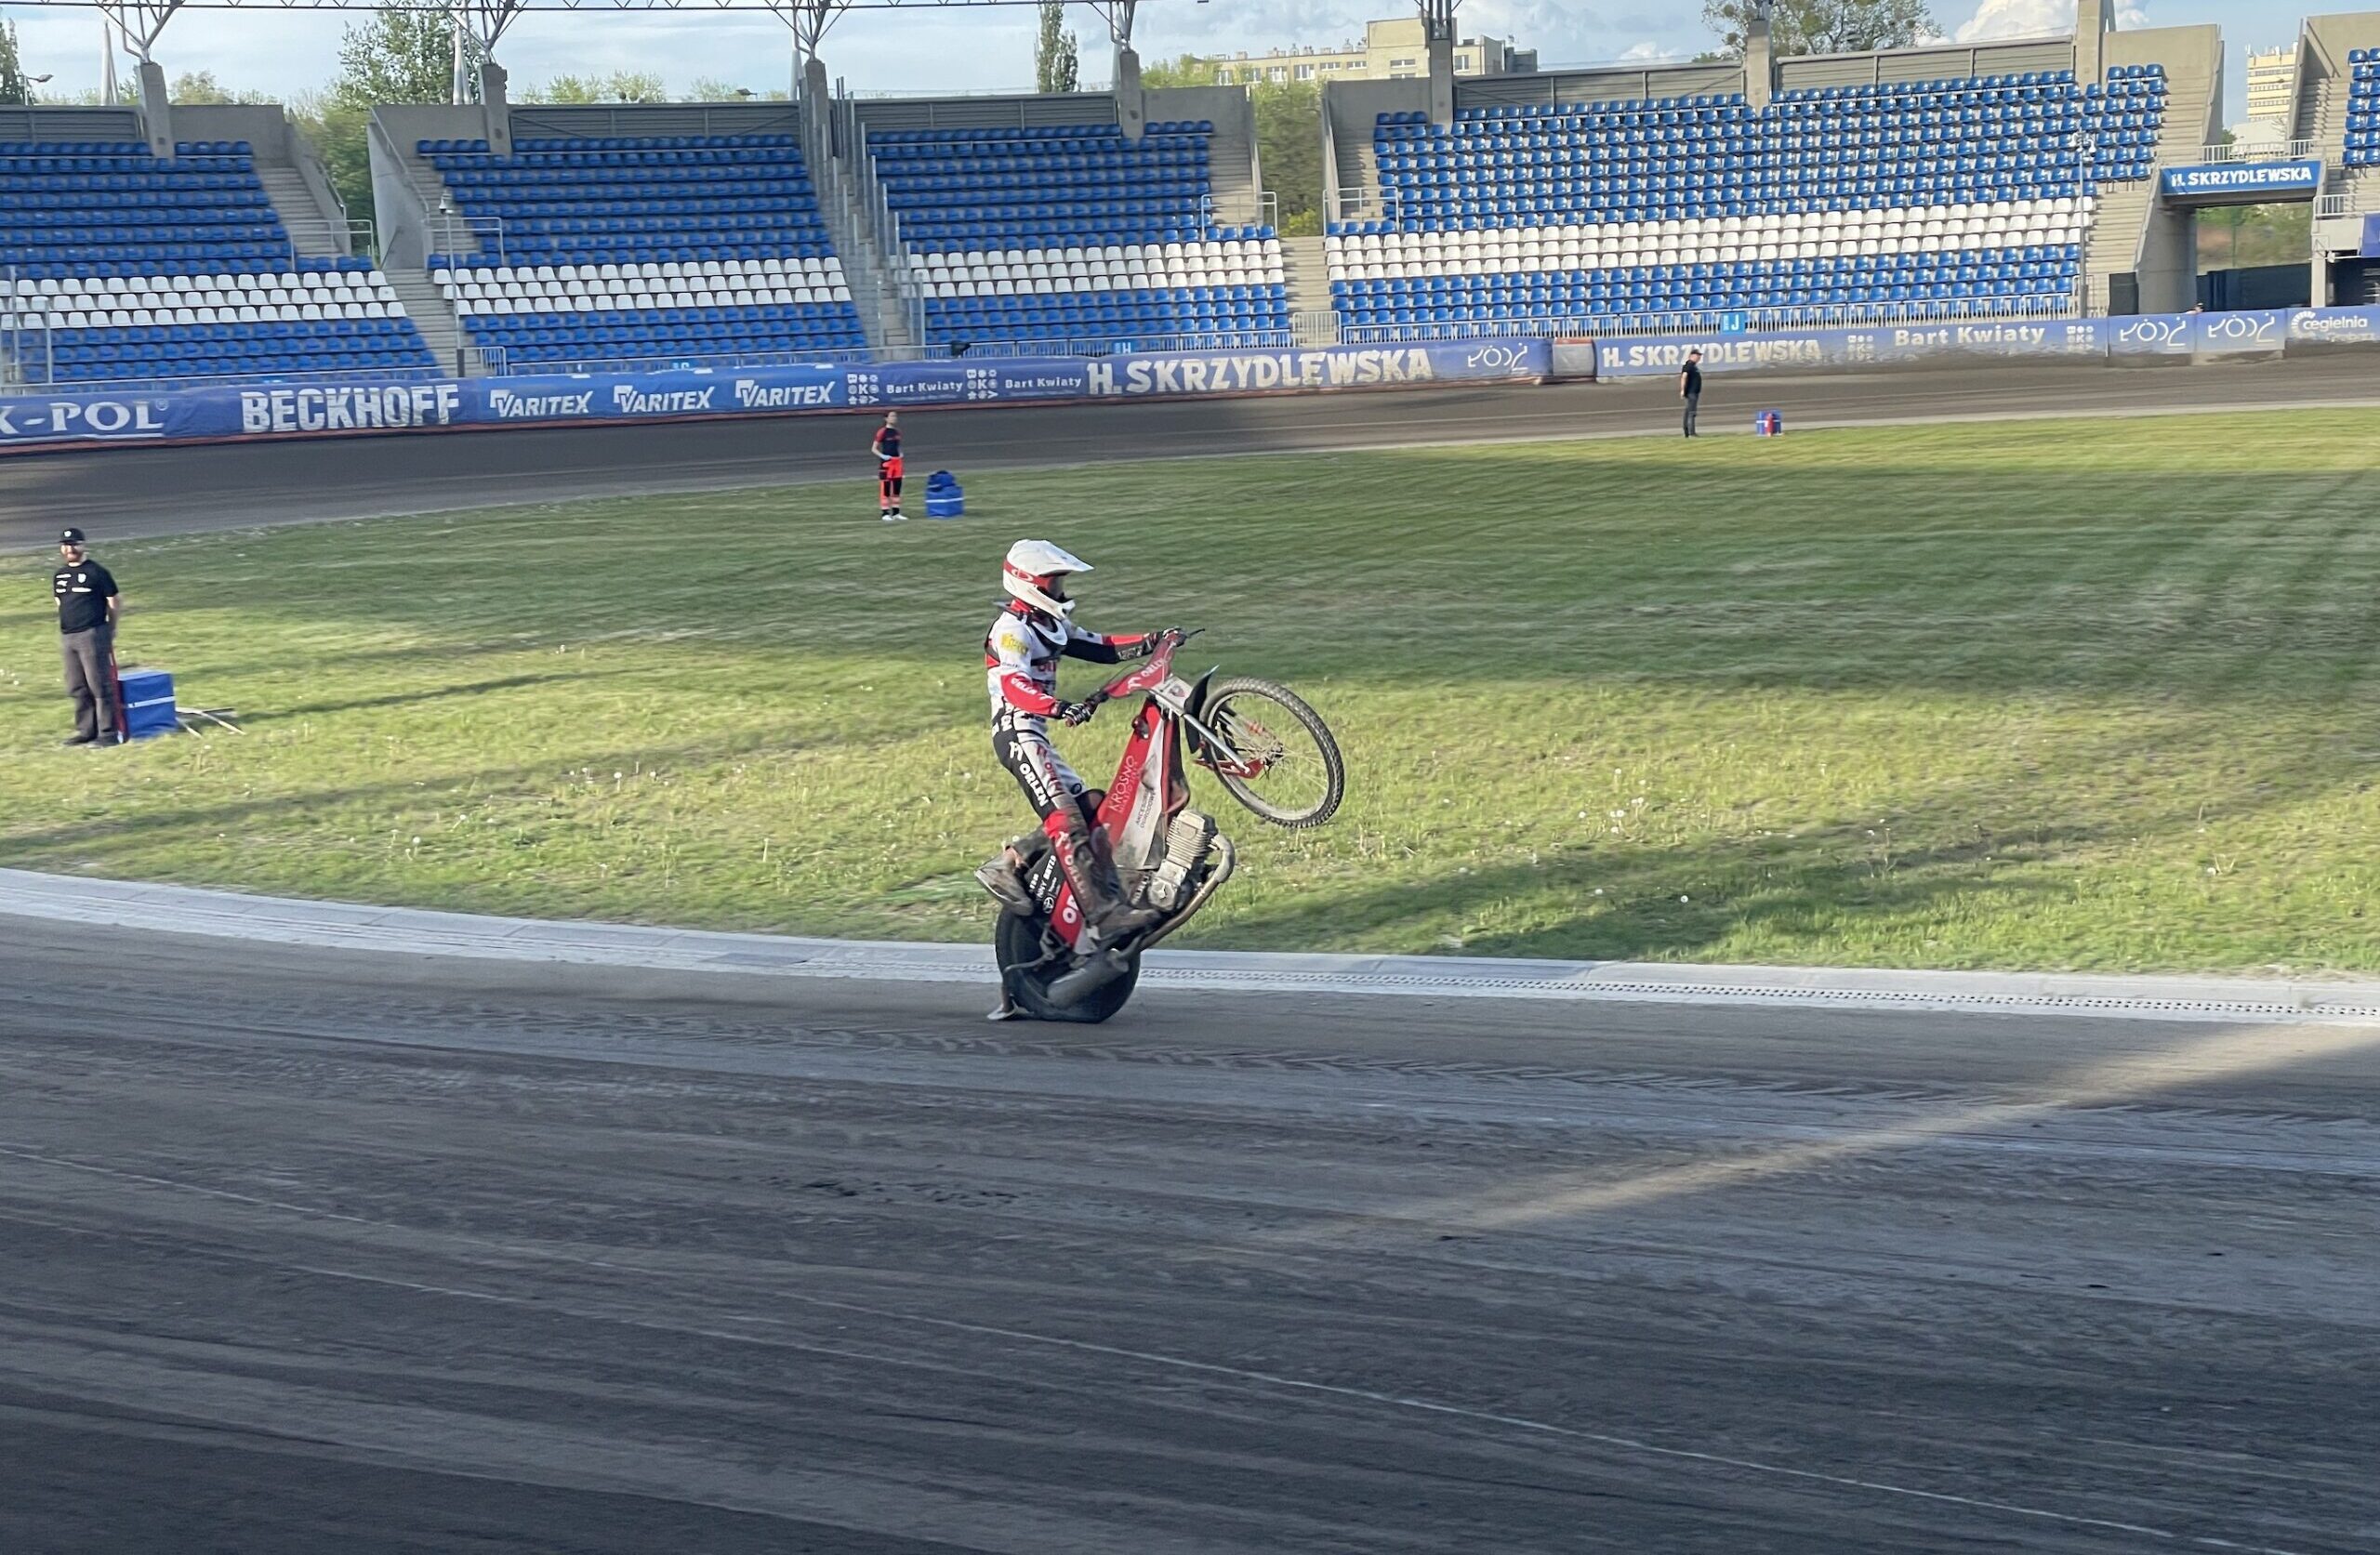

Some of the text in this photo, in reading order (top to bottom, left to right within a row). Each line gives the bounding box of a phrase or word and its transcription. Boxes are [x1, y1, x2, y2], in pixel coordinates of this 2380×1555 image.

[1895, 324, 2045, 347] Bart Kwiaty
[742, 381, 836, 407] VARITEX
[886, 381, 963, 394] Bart Kwiaty
[1005, 376, 1082, 389] Bart Kwiaty
[240, 384, 459, 433] BECKHOFF
[496, 390, 594, 417] VARITEX
[619, 386, 715, 414] VARITEX
[1019, 762, 1049, 807] ORLEN
